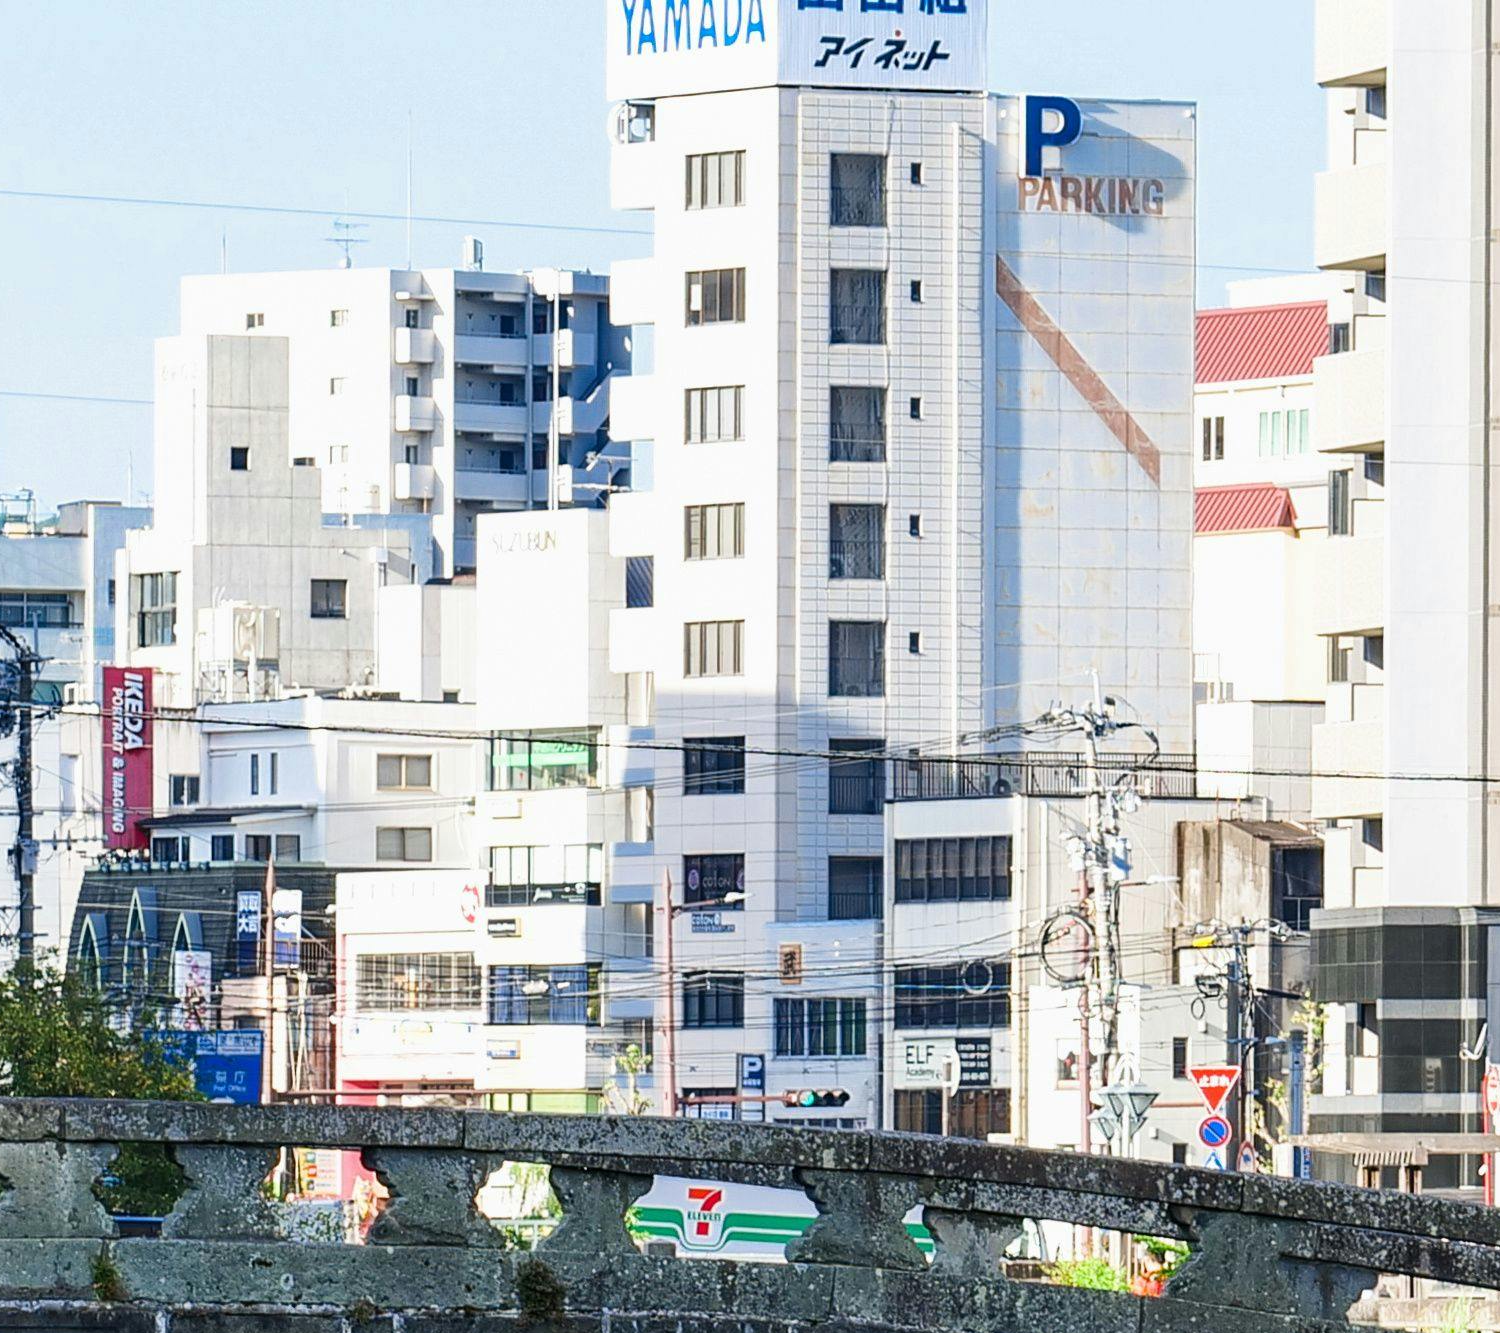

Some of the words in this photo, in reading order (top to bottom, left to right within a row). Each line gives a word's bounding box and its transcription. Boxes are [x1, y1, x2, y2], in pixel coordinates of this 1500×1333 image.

[622, 0, 766, 56] YAMADA
[814, 29, 950, 71] アイネット
[1025, 94, 1083, 177] P
[1018, 176, 1165, 215] PARKING
[112, 686, 125, 755] PORTRAIT
[124, 671, 144, 750] IKEDA
[112, 756, 125, 770] &
[112, 772, 125, 834] IMAGING
[743, 1056, 762, 1078] P
[905, 1045, 935, 1065] ELF
